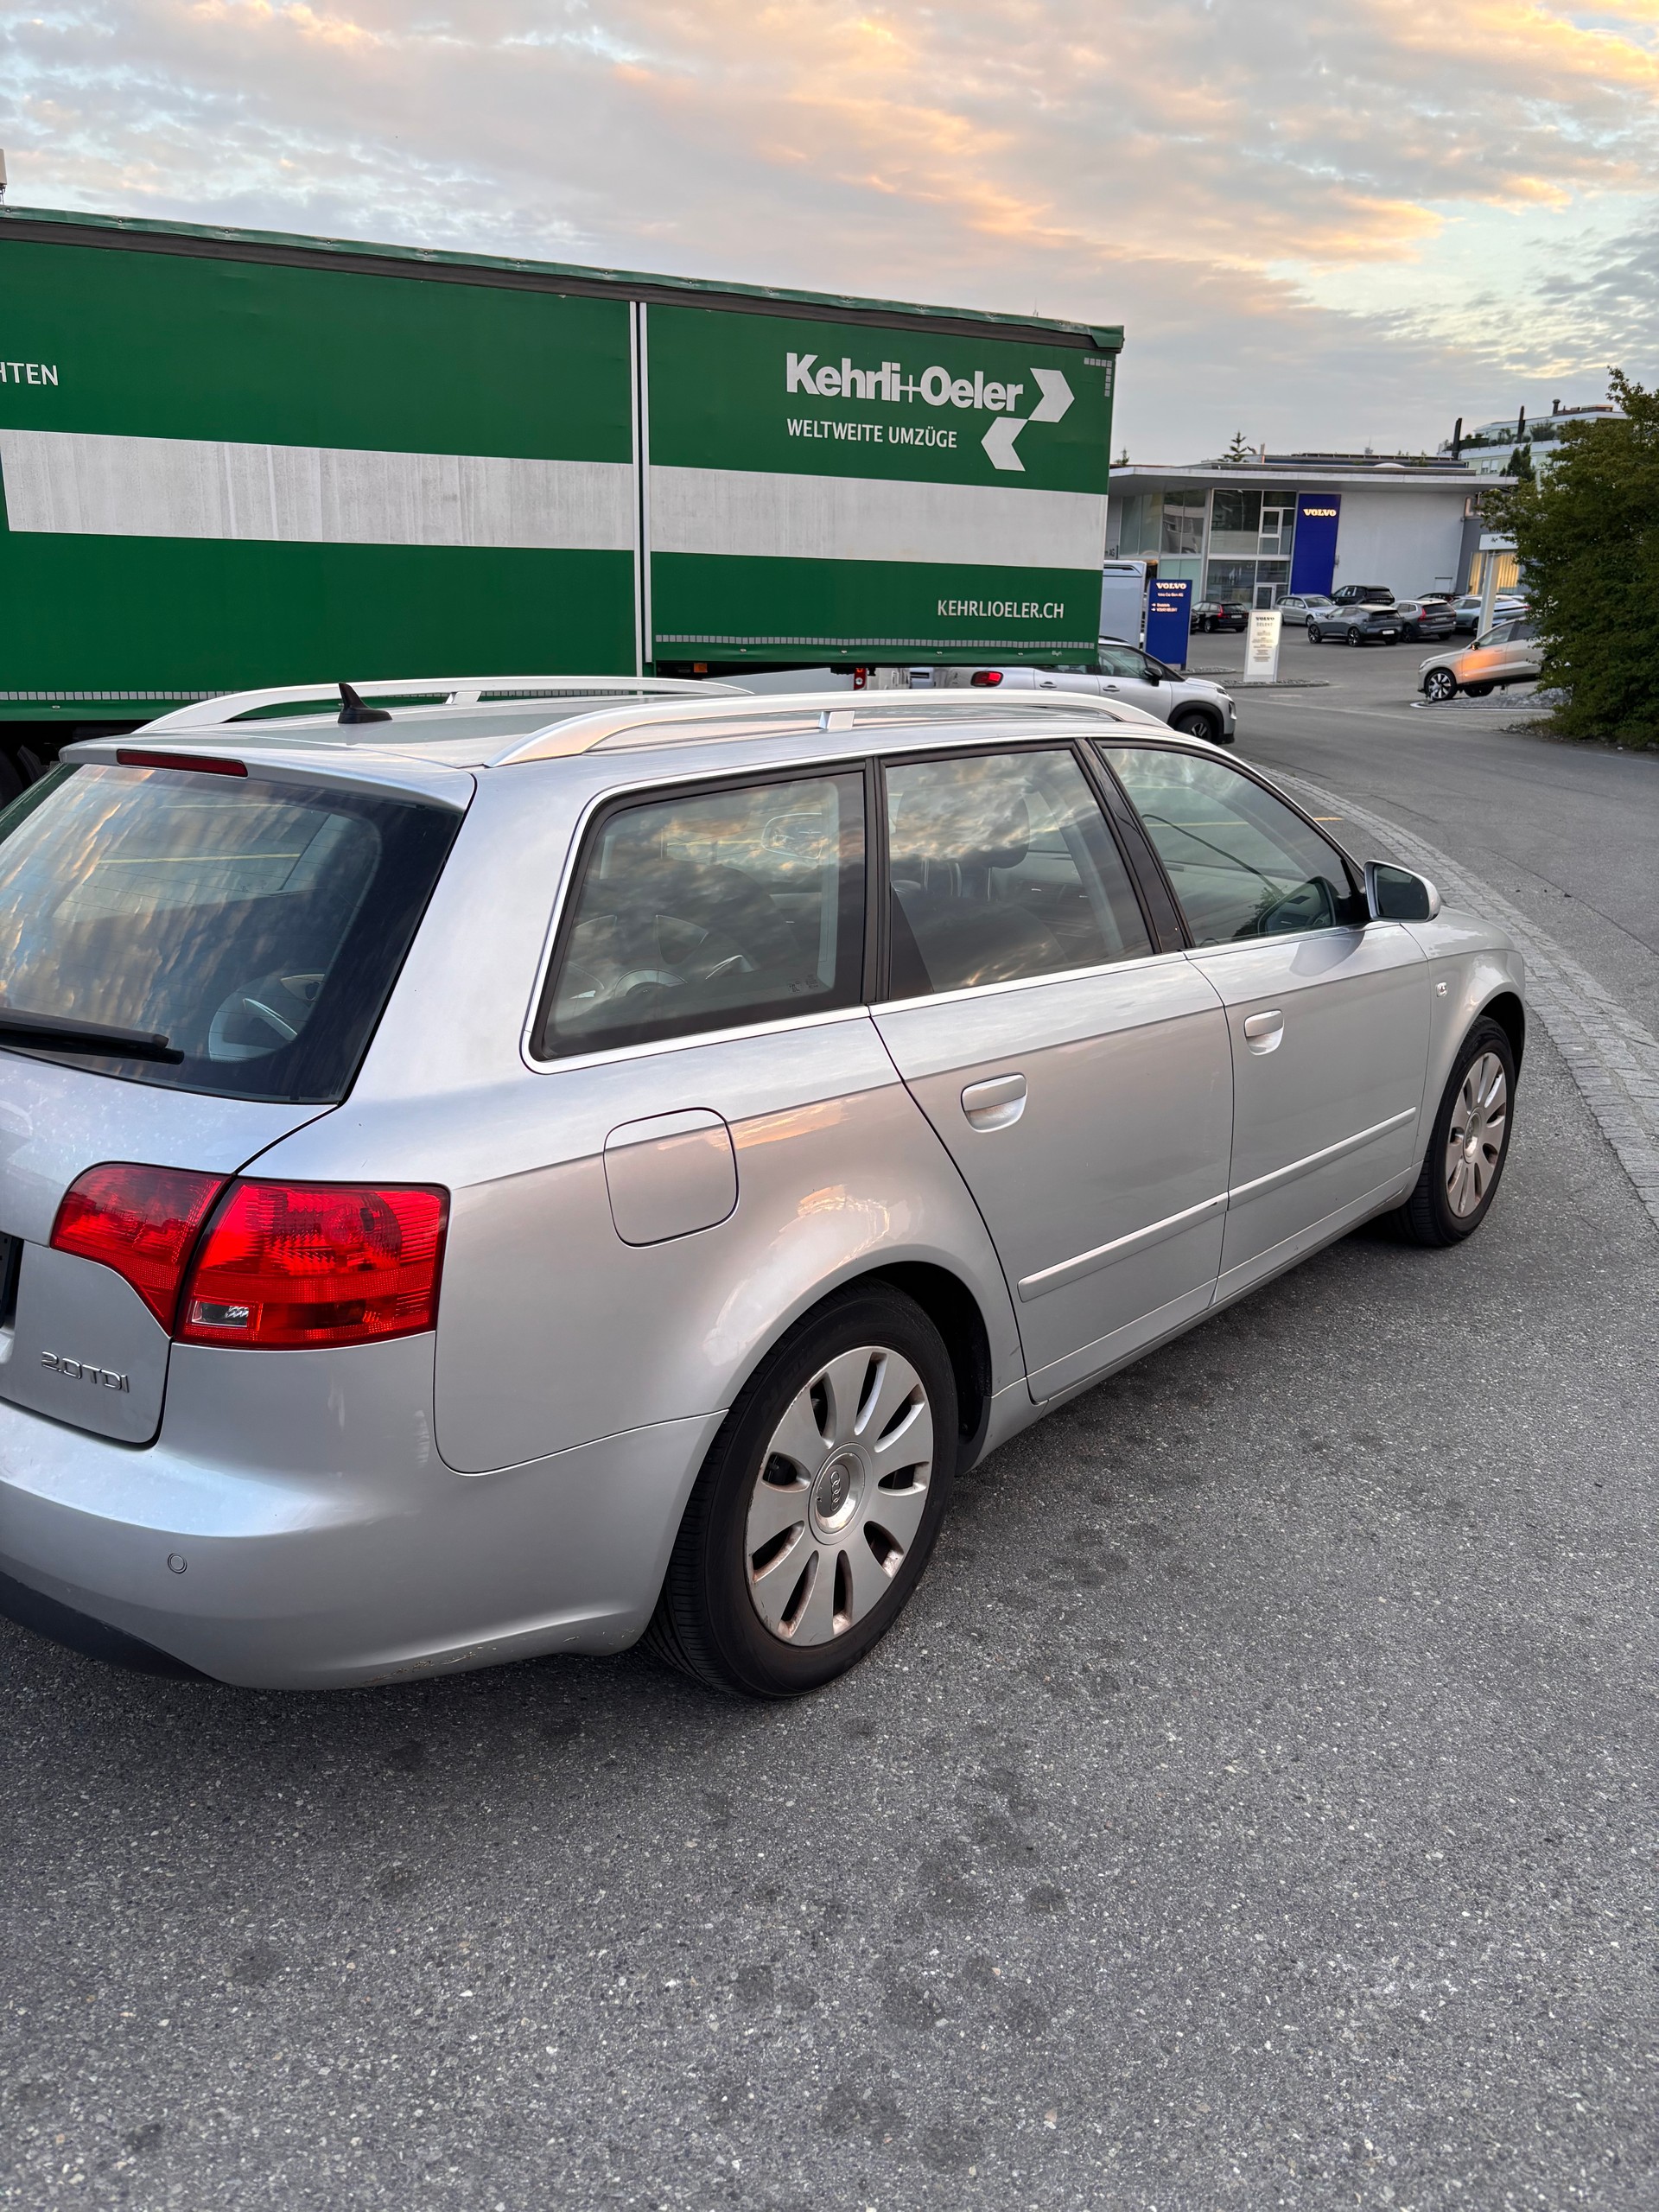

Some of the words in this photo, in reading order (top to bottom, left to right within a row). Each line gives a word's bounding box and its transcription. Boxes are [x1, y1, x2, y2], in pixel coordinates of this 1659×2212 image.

[786, 352, 1024, 412] Kehrli+Oeler
[786, 418, 884, 442] WELTWEITE
[888, 426, 957, 448] UMZÜGE
[1302, 508, 1337, 517] VOLVO
[937, 600, 1065, 619] KEHRLIOELER.CH
